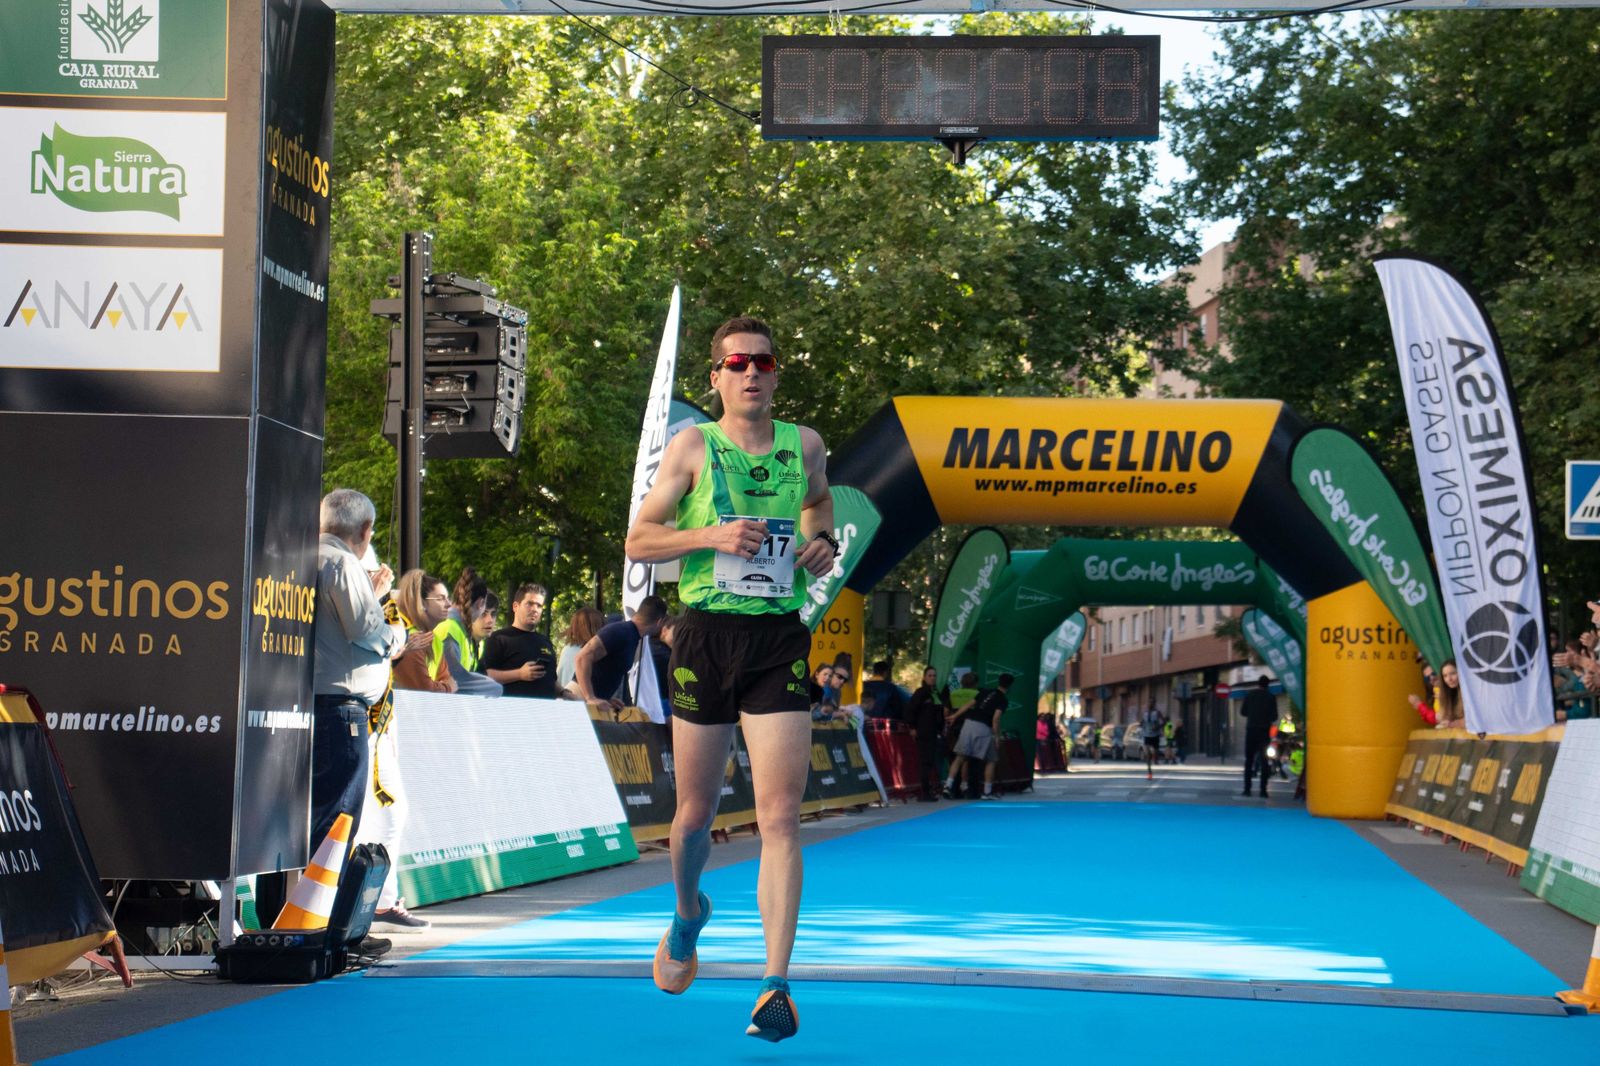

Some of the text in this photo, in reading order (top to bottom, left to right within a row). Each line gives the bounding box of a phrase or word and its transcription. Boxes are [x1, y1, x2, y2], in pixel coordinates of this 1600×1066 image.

[58, 0, 69, 59] fundaci
[59, 63, 159, 79] CAJA RURAL
[79, 79, 138, 89] GRANADA
[33, 153, 185, 195] Natura
[114, 151, 152, 163] Sierra
[266, 125, 330, 198] agustinos
[272, 182, 316, 227] GRANADA
[3, 279, 203, 331] ANAYA
[942, 427, 1233, 474] MARCELINO
[974, 475, 1198, 498] www.mpmarcelino.es
[1084, 553, 1255, 591] El Corte Inglés
[0, 565, 230, 631] gustinos
[253, 570, 316, 632] agustinos
[939, 554, 998, 648] El Corte Inglés
[0, 630, 182, 656] GRANADA
[262, 631, 305, 656] GRANADA
[1320, 622, 1408, 650] agustin
[45, 706, 222, 734] pmarcelino.es
